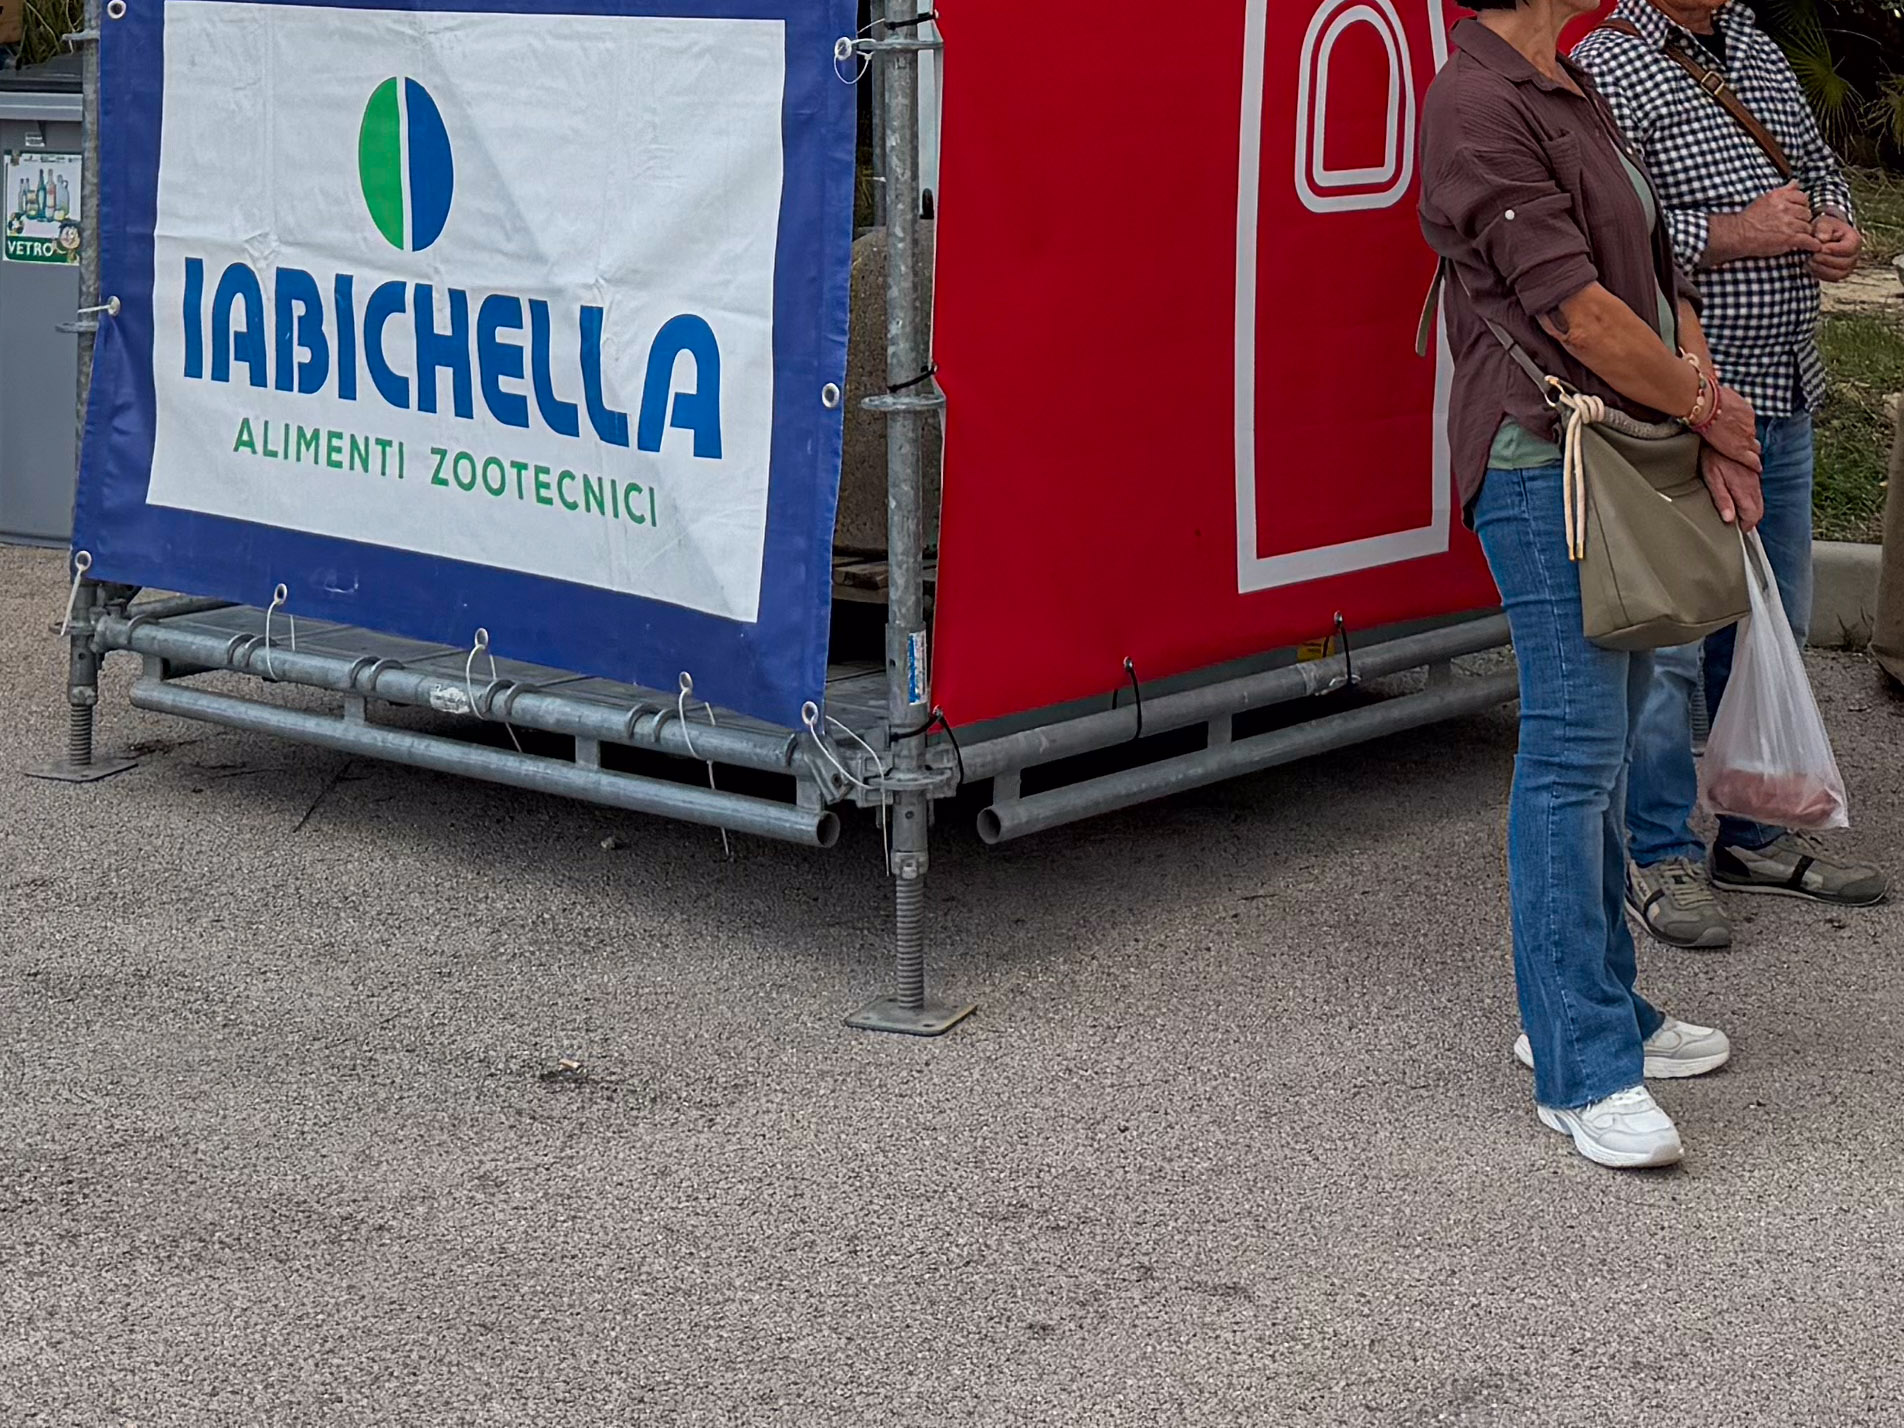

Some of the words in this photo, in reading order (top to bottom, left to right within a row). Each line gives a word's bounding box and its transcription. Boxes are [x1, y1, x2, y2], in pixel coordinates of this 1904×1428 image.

[7, 240, 54, 257] VETRO
[183, 257, 723, 460] IABICHELLA
[233, 417, 406, 480] ALIMENTI
[430, 447, 658, 528] ZOOTECNICI
